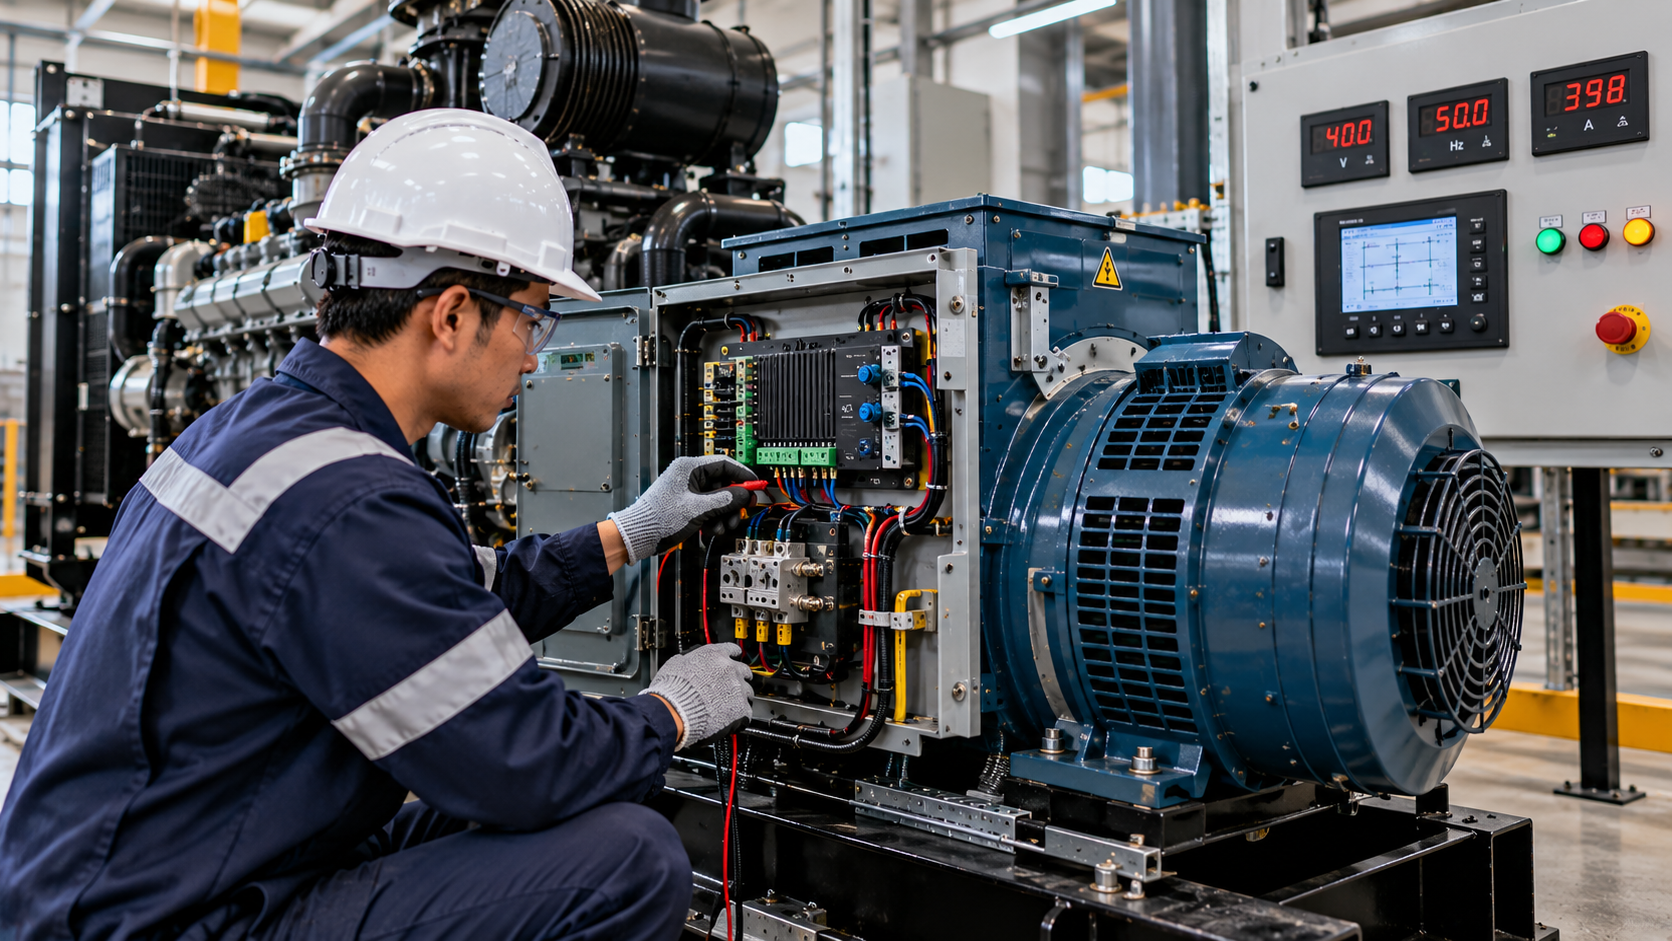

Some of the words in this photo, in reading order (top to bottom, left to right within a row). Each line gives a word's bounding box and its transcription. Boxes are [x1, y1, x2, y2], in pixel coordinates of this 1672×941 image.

[1564, 74, 1626, 112] 398
[1436, 98, 1489, 132] 50.0
[1583, 119, 1594, 131] A
[1450, 139, 1464, 151] Hz
[1339, 157, 1348, 168] V
